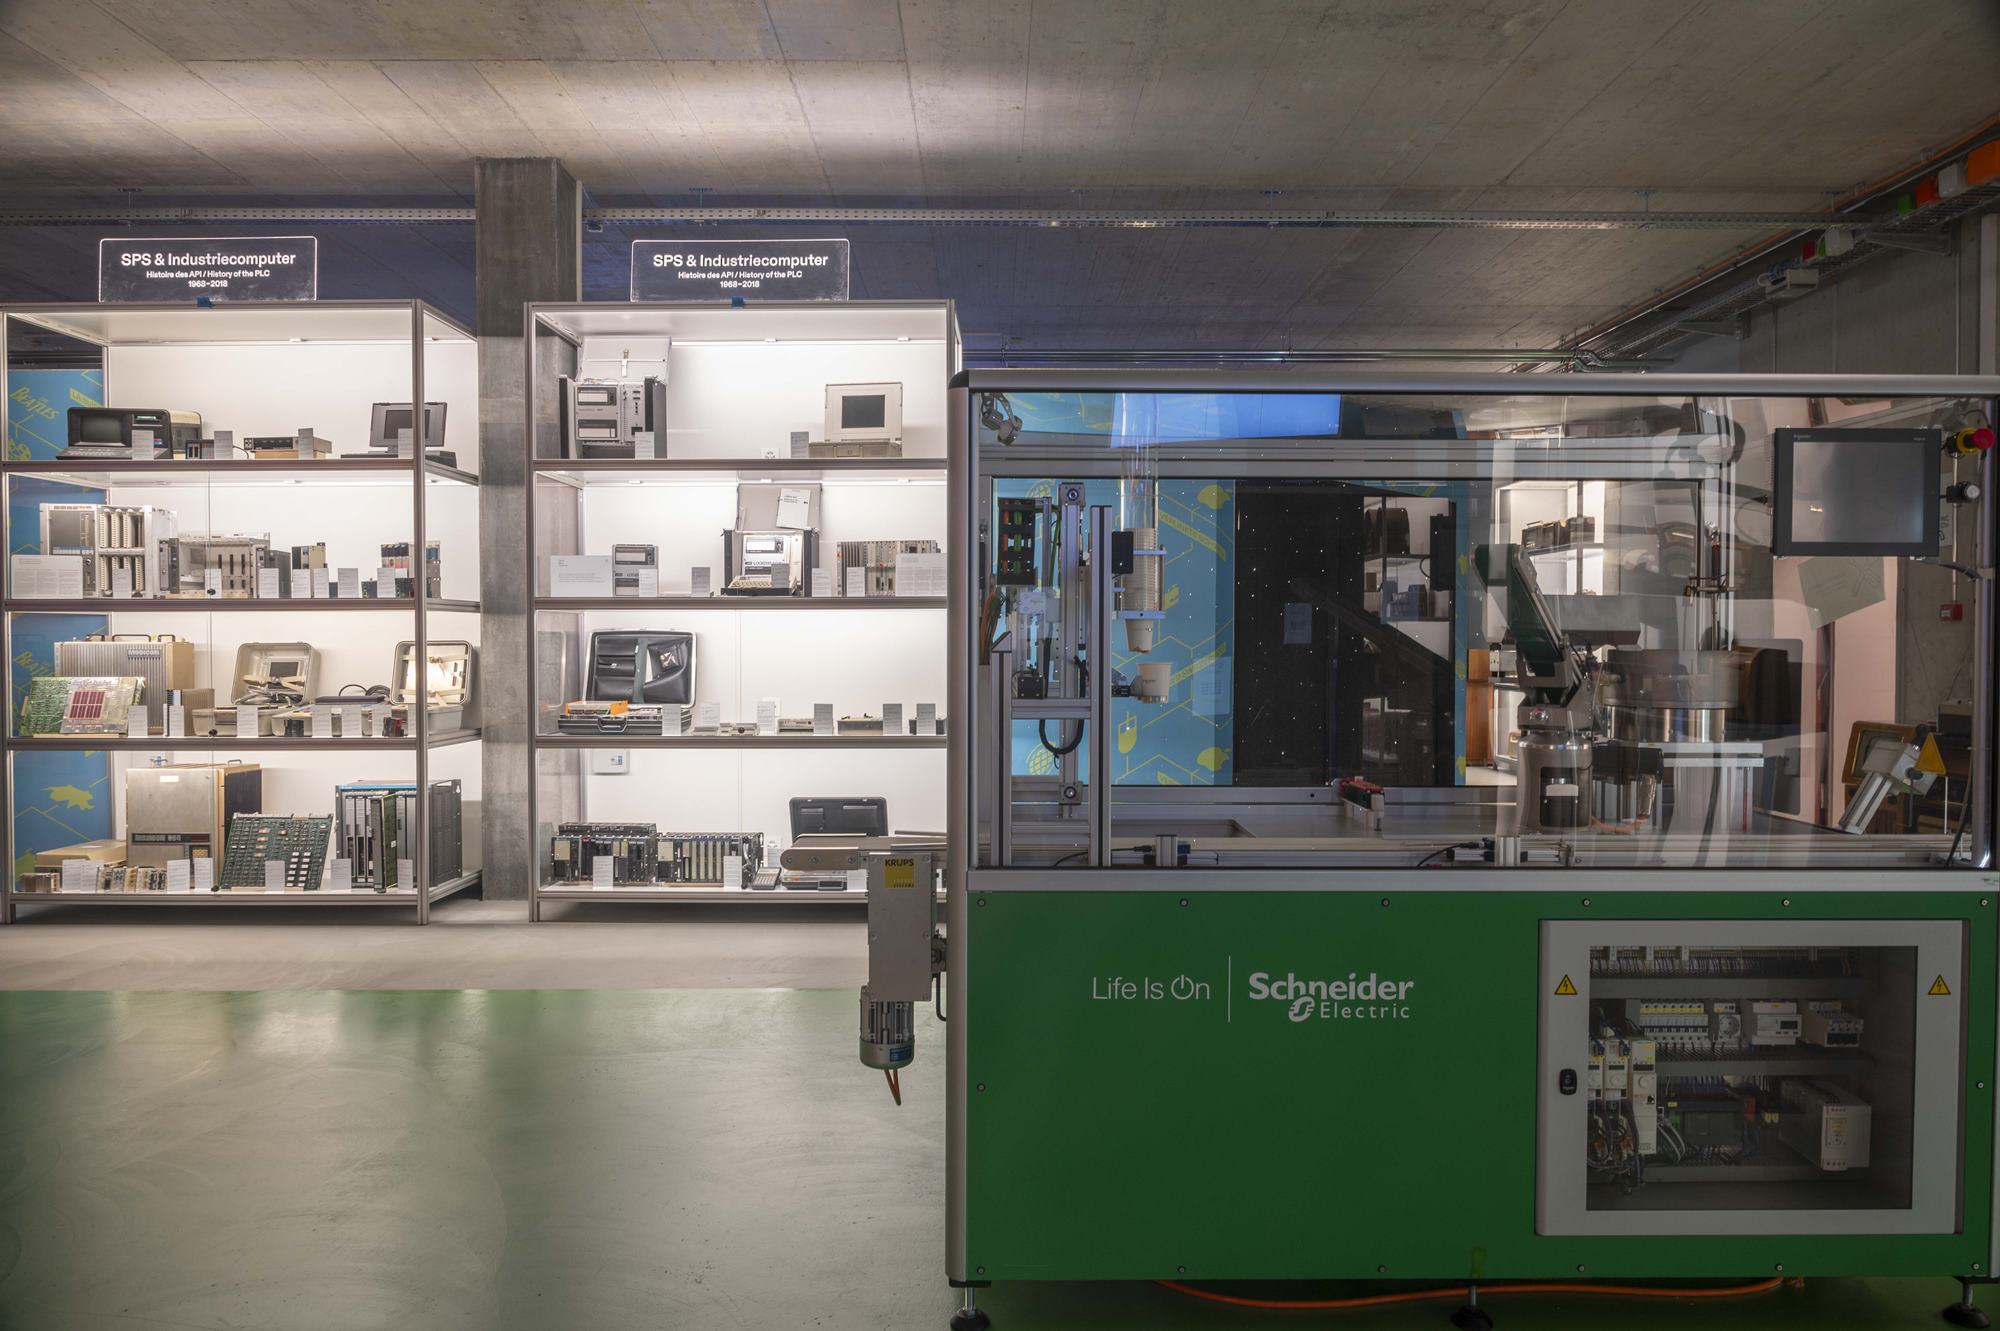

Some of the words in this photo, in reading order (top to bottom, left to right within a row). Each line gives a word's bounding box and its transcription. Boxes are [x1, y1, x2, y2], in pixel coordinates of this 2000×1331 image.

[120, 253, 151, 267] SPS
[154, 253, 165, 267] &
[168, 252, 296, 268] Industriecomputer
[652, 254, 684, 268] SPS
[686, 254, 697, 268] &
[700, 253, 829, 269] Industriecomputer
[146, 271, 174, 279] Histoire
[175, 271, 189, 279] des
[189, 270, 202, 278] API
[207, 270, 233, 279] History
[233, 270, 241, 278] of
[254, 269, 271, 277] PLC
[678, 271, 706, 280] Histoire
[707, 271, 720, 279] des
[721, 271, 734, 279] API
[739, 271, 765, 280] History
[786, 270, 803, 278] PLC
[884, 858, 914, 867] KRUPS
[1093, 976, 1137, 1000] Life
[1144, 976, 1165, 1000] Is
[1170, 974, 1211, 1000] On
[1248, 971, 1415, 1001] Schneider
[1320, 1001, 1410, 1019] Electric
